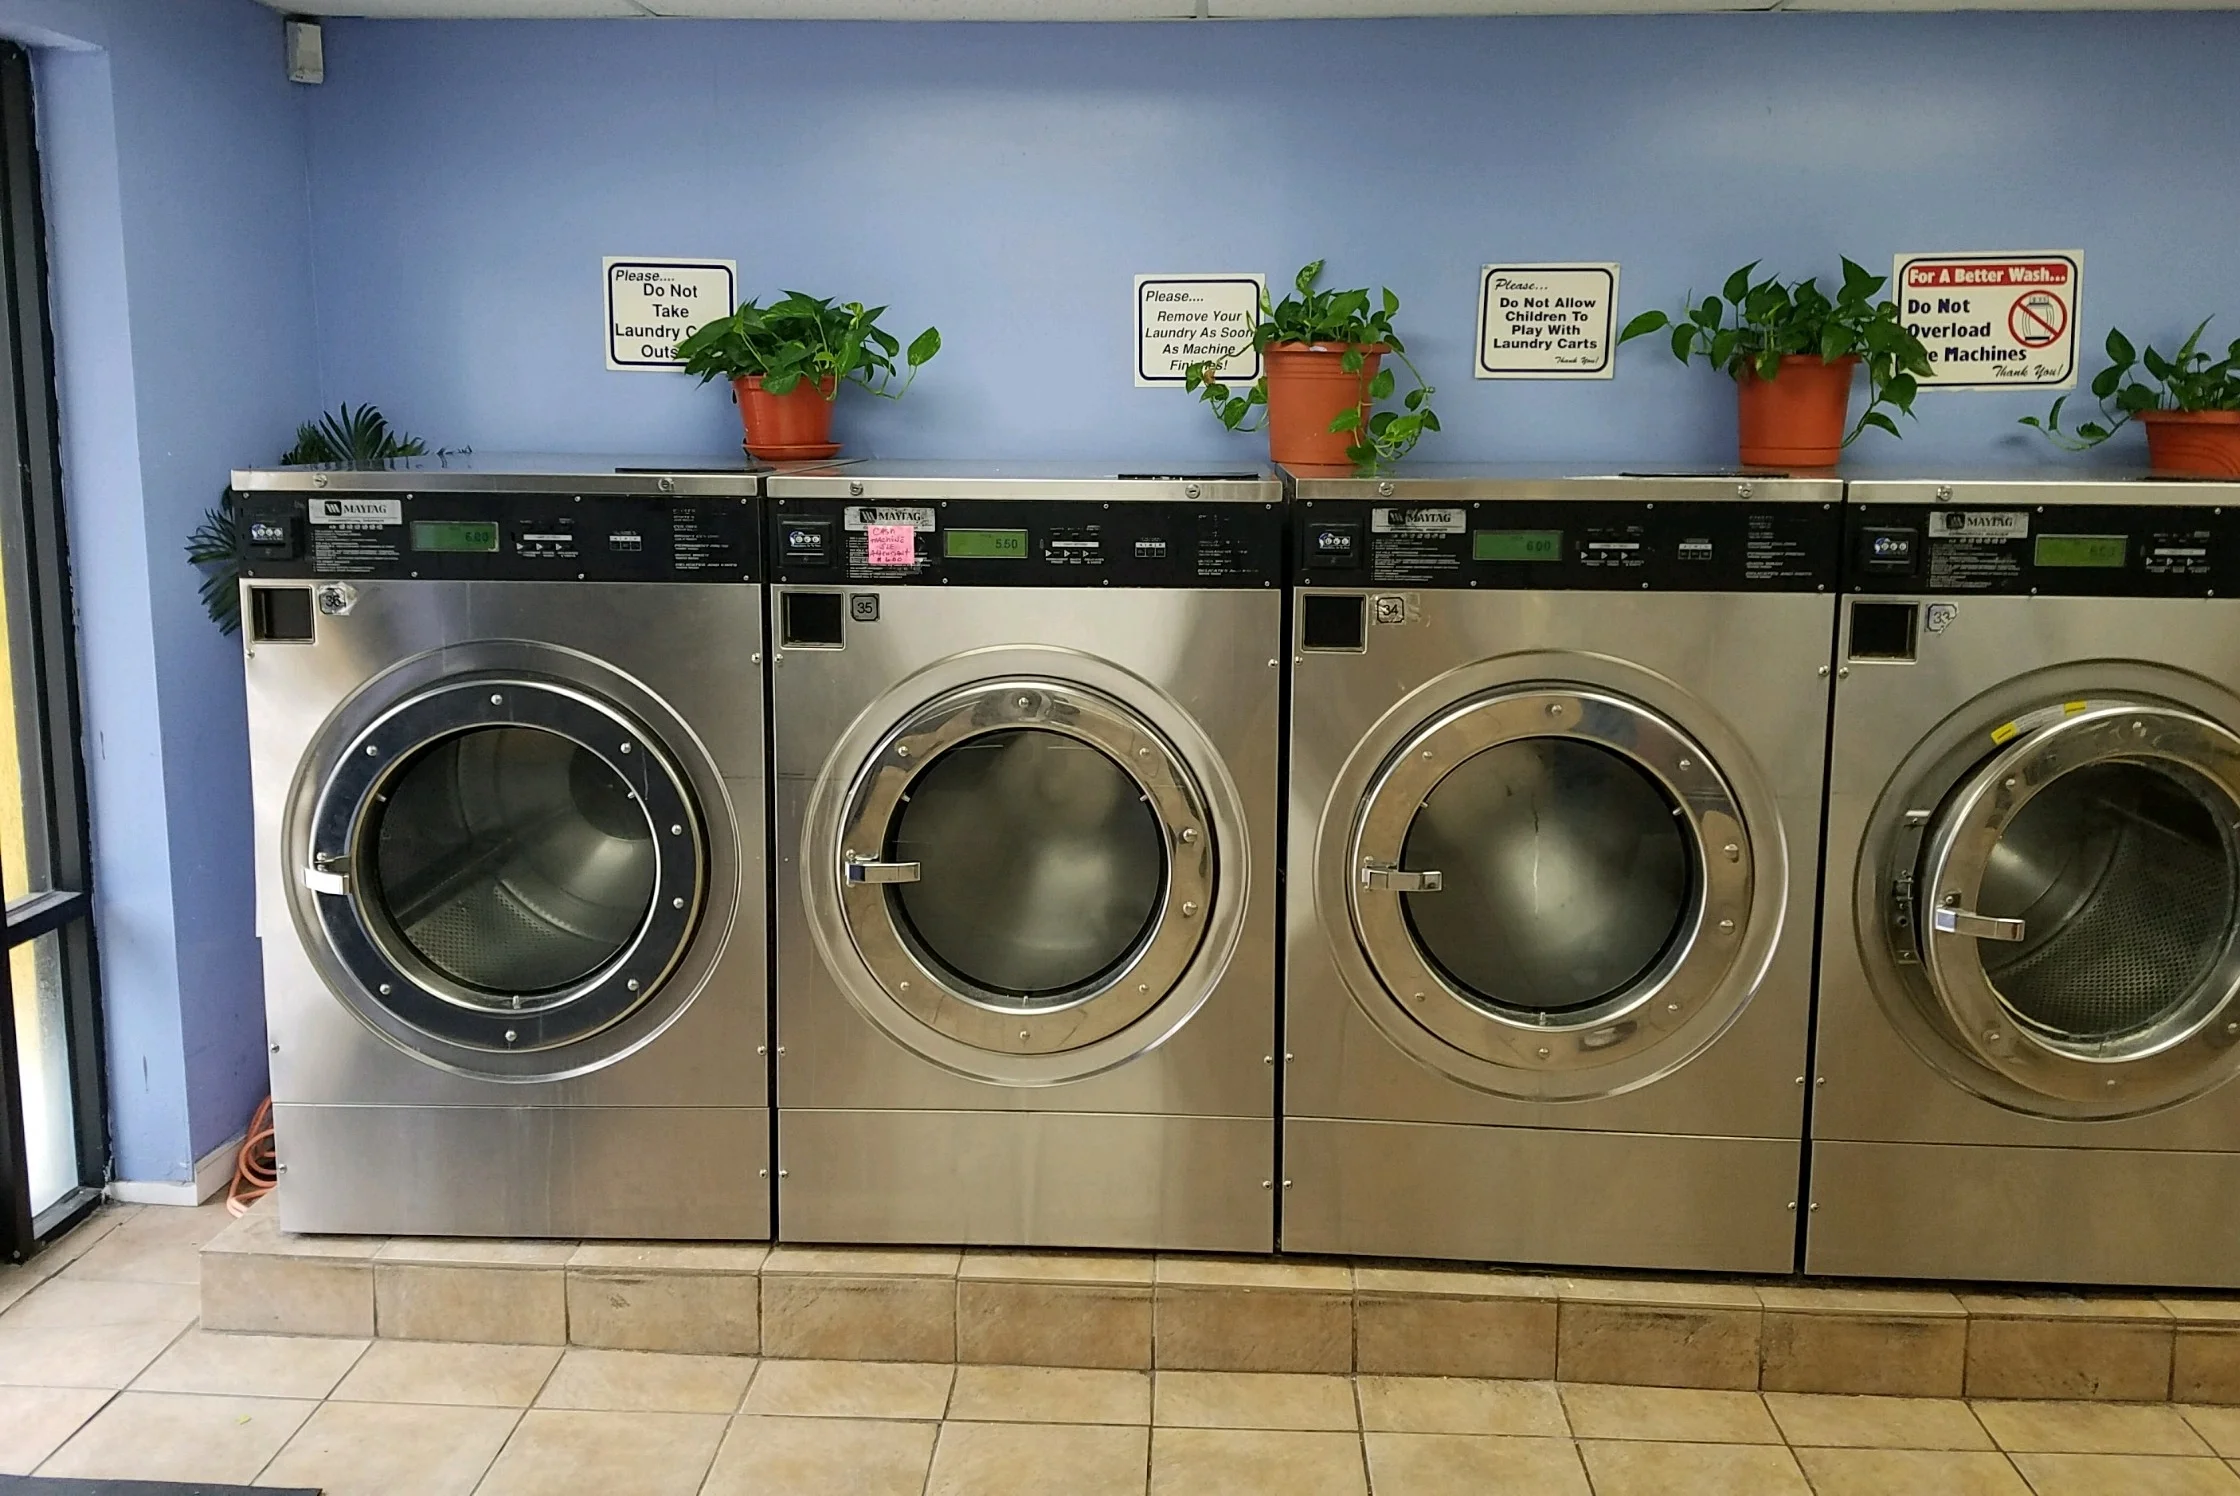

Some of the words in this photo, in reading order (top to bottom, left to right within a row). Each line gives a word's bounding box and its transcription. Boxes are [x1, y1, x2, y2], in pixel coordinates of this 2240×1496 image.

[1909, 268, 1935, 284] For
[1939, 268, 1950, 283] A
[1955, 266, 2004, 283] Better
[2008, 265, 2066, 282] Wash...
[644, 283, 665, 297] Do
[671, 284, 698, 299] Not
[1500, 298, 1518, 308] Do
[1524, 297, 1550, 308] Not
[1555, 297, 1597, 308] Allow
[1908, 298, 1931, 314] Do
[1937, 298, 1971, 314] Not
[652, 304, 689, 318] Take
[1157, 311, 1208, 322] Remove
[1213, 310, 1242, 322] Your
[1505, 311, 1567, 322] Children
[1572, 311, 1588, 322] To
[615, 323, 680, 341] Laundry
[1145, 327, 1197, 341] Laundry
[1199, 327, 1216, 338] As
[1220, 326, 1254, 338] Soon
[1512, 325, 1543, 337] Play
[1548, 324, 1581, 335] With
[1908, 321, 1991, 339] Overload
[1162, 344, 1179, 354] As
[1182, 343, 1236, 355] Machine
[1493, 338, 1552, 351] Laundry
[1557, 338, 1598, 349] Carts
[1944, 345, 2027, 362] Machines
[1555, 356, 1578, 364] Thank
[1581, 356, 1599, 365] You!
[1992, 363, 2028, 378] Thank
[2034, 362, 2063, 379] You!
[344, 504, 387, 514] MAYTAG
[879, 511, 922, 521] MAYTAG
[1407, 513, 1451, 523] MAYTAG
[1967, 517, 2013, 527] MAYTAG
[326, 595, 341, 607] 36
[857, 602, 873, 614] 35
[1381, 604, 1398, 616] 34
[1934, 611, 1951, 624] 33
